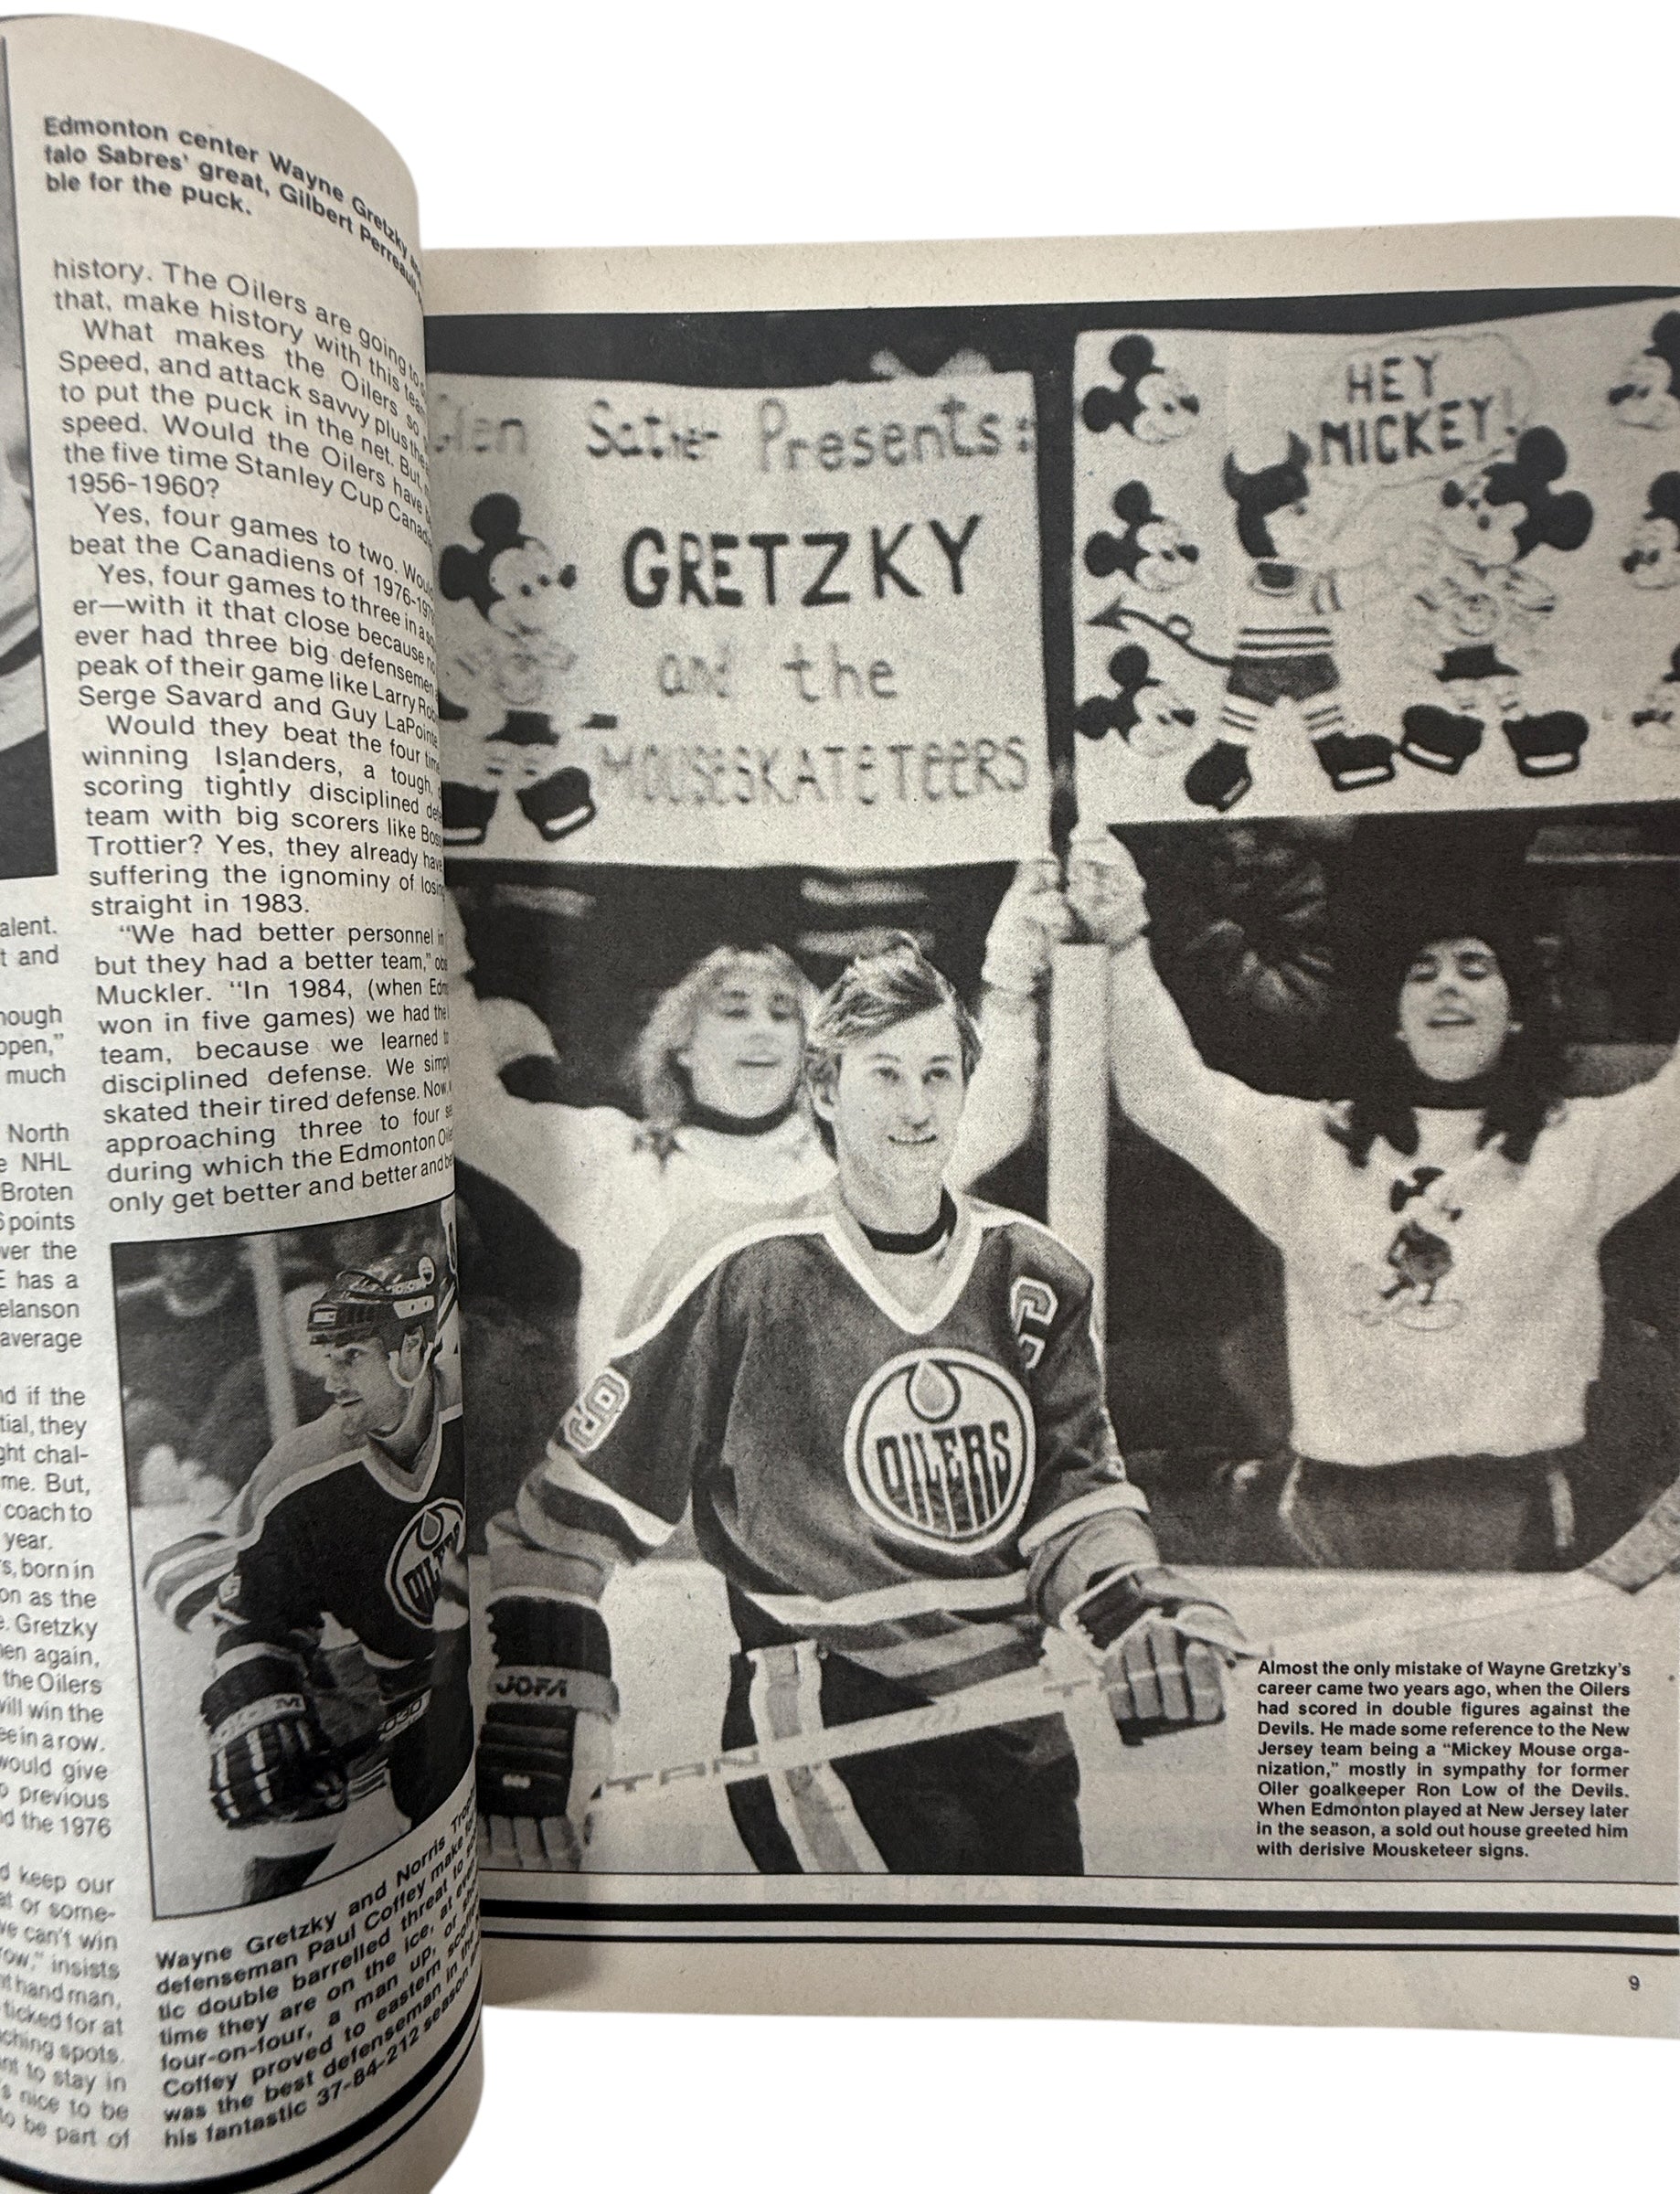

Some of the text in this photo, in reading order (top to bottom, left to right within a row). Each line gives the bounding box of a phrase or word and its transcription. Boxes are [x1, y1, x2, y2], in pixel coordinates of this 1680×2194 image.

[44, 116, 407, 261] Edmonton center Wayne Gretzky
[44, 144, 87, 164] falo
[98, 144, 188, 171] Sabres'
[198, 162, 270, 197] great,
[279, 183, 353, 234] Gilbert
[47, 172, 250, 215] ble for the puck.
[54, 259, 406, 376] history. The Oilers are going
[1346, 351, 1441, 403] HEY
[68, 473, 219, 498] 1956-1960?
[622, 515, 982, 607] GRETZKY
[783, 643, 898, 702] the
[79, 686, 155, 710] Serge
[166, 685, 261, 709] Savard
[274, 697, 321, 715] and
[332, 700, 377, 729] Guy
[91, 893, 308, 920] straight in 1983.
[97, 983, 211, 1005] Muckler.
[289, 979, 351, 999] 1984,
[368, 978, 421, 1000] (when
[8, 1123, 69, 1143] North
[22, 1153, 71, 1171] NHL
[9, 1211, 75, 1235] points
[1010, 1276, 1058, 1369] C
[876, 1420, 1012, 1532] OILERS
[16, 1614, 98, 1642] Gretzky
[35, 1646, 99, 1669] again,
[1259, 1660, 1317, 1675] Almost
[1323, 1661, 1349, 1675] the
[1354, 1661, 1390, 1678] only
[1396, 1661, 1462, 1675] mistake
[1466, 1661, 1483, 1676] of
[1488, 1661, 1545, 1678] Wayne
[3, 1669, 102, 1695] the Oilers
[1258, 1682, 1630, 1699] career came two years ago, when the Oilers
[1258, 1700, 1630, 1719] had scored in double figures against the
[1259, 1721, 1630, 1737] Devils. He made some reference to the New
[1258, 1741, 1313, 1759] Jersey
[1321, 1742, 1362, 1755] team
[1371, 1742, 1418, 1760] being
[1426, 1745, 1435, 1756] a
[1519, 1742, 1576, 1756] Mouse
[1582, 1746, 1629, 1760] orga-
[1349, 1763, 1406, 1780] mostly
[1418, 1763, 1431, 1776] in
[1443, 1763, 1526, 1780] sympathy
[1537, 1763, 1561, 1776] for
[1571, 1763, 1629, 1777] former
[19, 1786, 109, 1809] previous
[1259, 1781, 1629, 1799] Oiler goalkeeper Ron Low of the Devils.
[21, 1811, 112, 1838] the 1976
[1258, 1802, 1629, 1821] When Edmonton played at New Jersey later
[1257, 1821, 1628, 1840] in the season, a sold out house greeted him
[1257, 1842, 1528, 1860] with derisive Mousketeer signs.
[155, 1837, 445, 1971] Wayne Gretzky and Norris
[155, 1836, 463, 1996] defenseman Paul Coffey make
[158, 1883, 448, 2021] tic double barrelled threat
[159, 1924, 435, 2046] time they are on the ice,
[1629, 1975, 1640, 1990] 9
[159, 1946, 435, 2072] four-on-four, a man up,
[163, 1959, 441, 2097] Coffey proved to eastern
[165, 1978, 441, 2122] was the best defenseman
[165, 1967, 470, 2147] his fantastic 37-84-212 season
